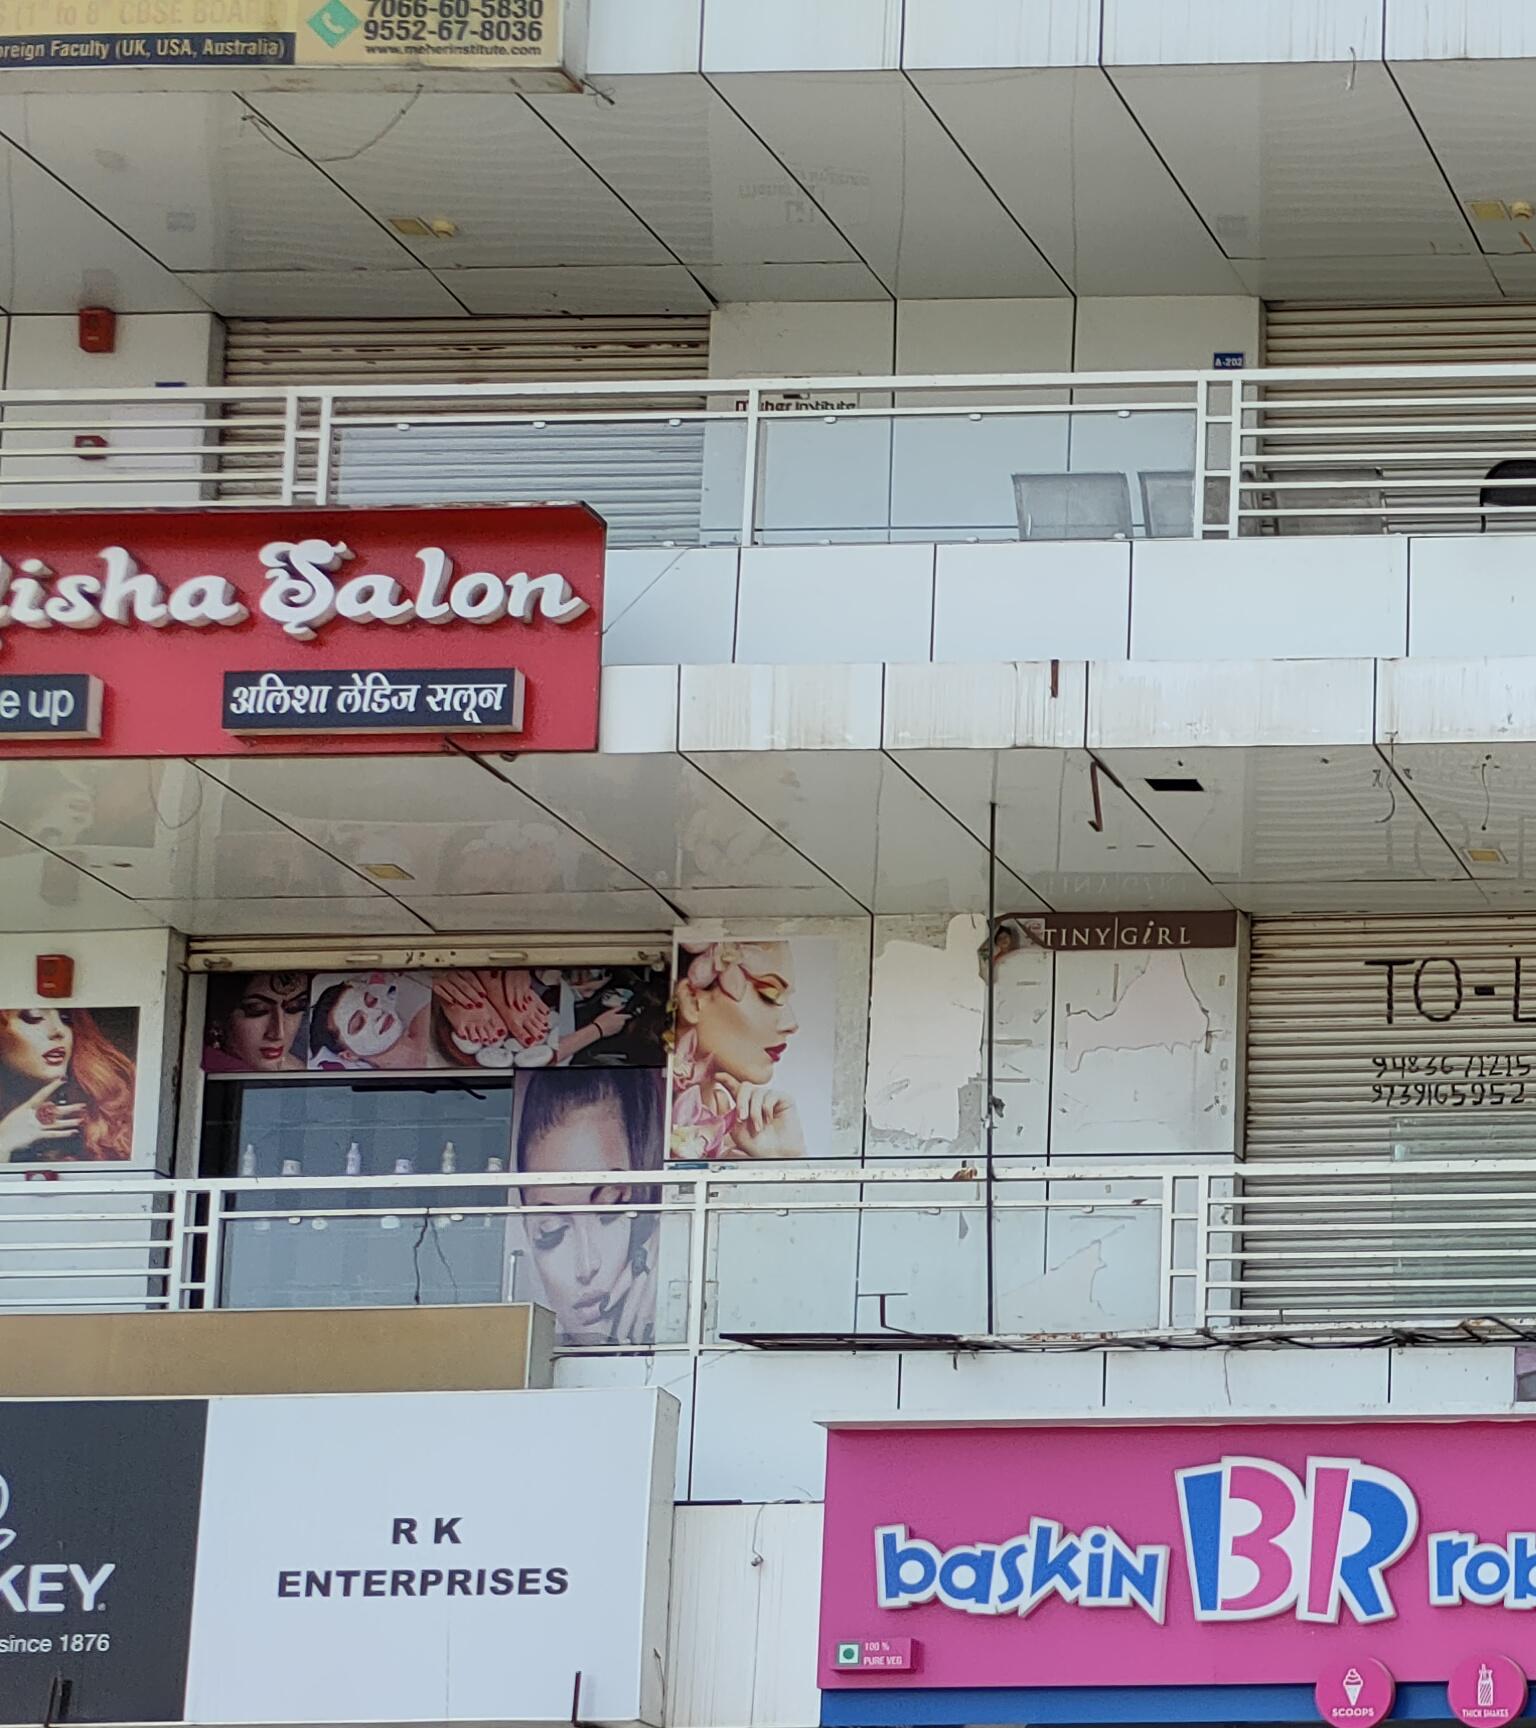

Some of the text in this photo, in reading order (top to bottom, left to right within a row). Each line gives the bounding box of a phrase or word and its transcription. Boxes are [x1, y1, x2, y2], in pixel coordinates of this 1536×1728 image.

[364, 20, 543, 41] 9552-67-8036
[50, 36, 286, 59] Faculty (UK, USA, Australia)
[365, 44, 542, 56] www.meherinstitute.com
[259, 539, 590, 641] Salon
[29, 686, 75, 725] up
[230, 672, 507, 724] अलिशा लेडिज सलून
[391, 1516, 463, 1545] R K
[277, 1567, 570, 1598] ENTERPRISES
[874, 1516, 1170, 1625] baskin
[0, 1634, 110, 1653] since 1876
[1332, 1707, 1374, 1718] SCOOPS
